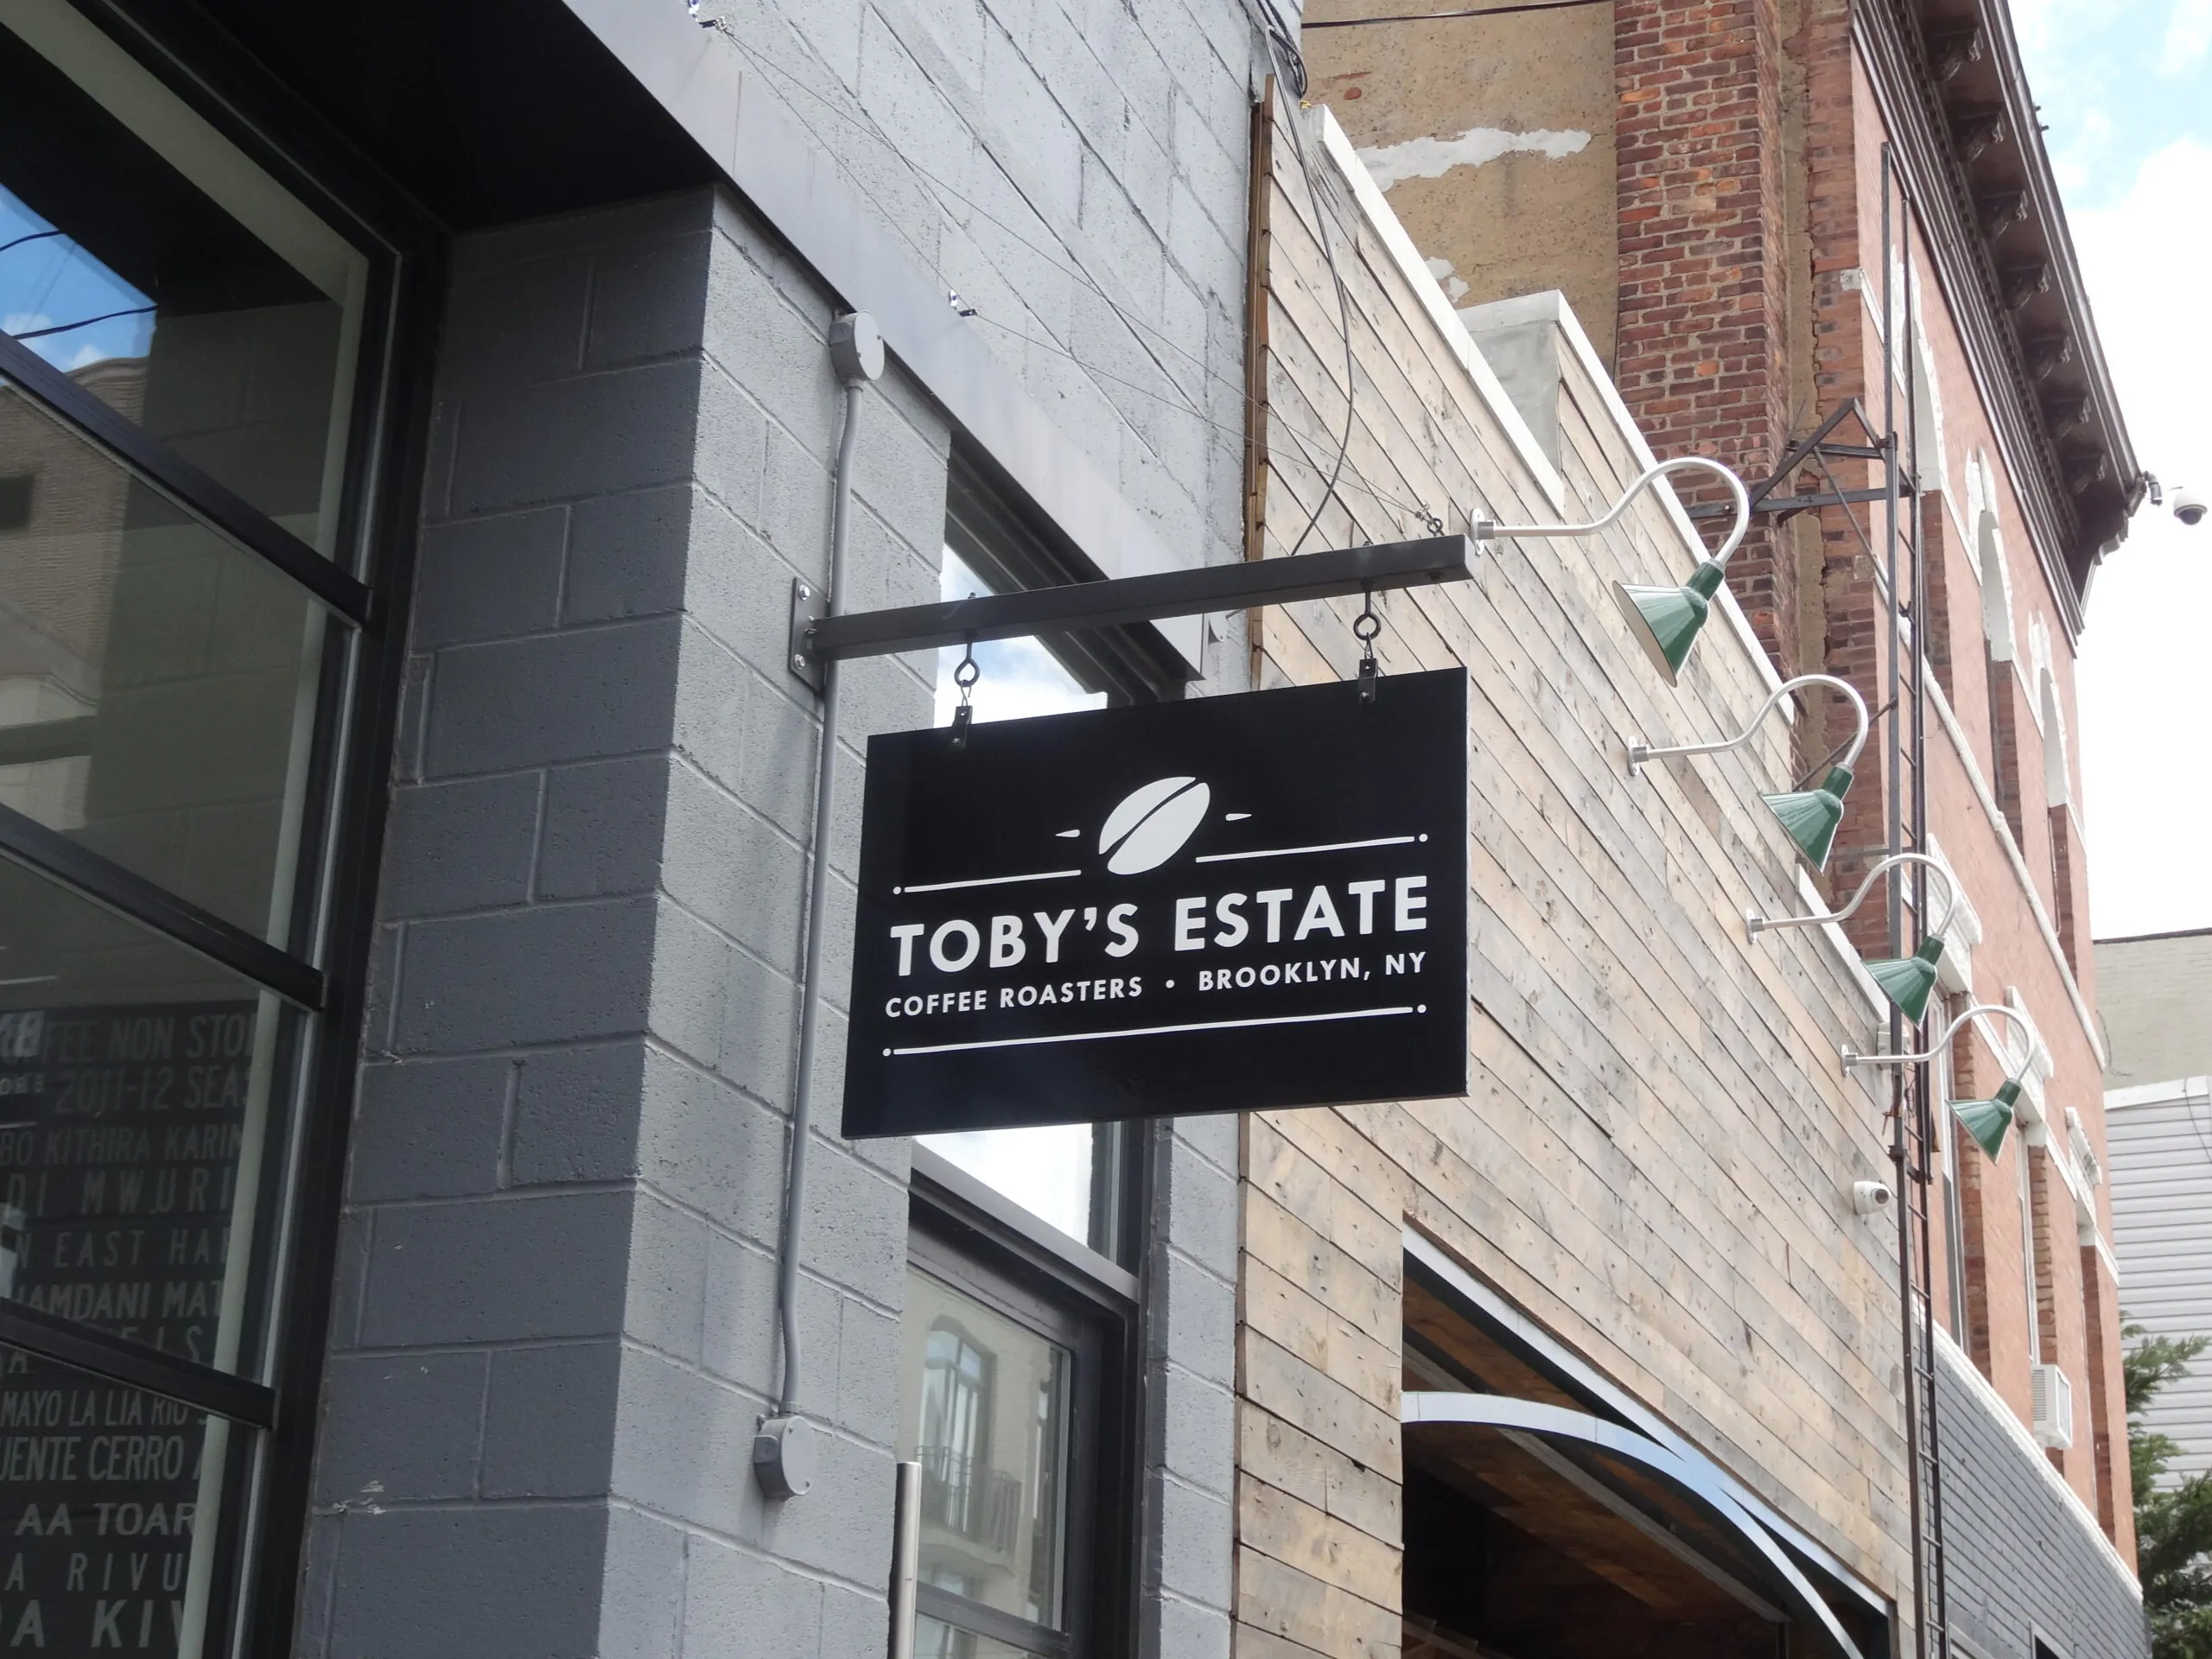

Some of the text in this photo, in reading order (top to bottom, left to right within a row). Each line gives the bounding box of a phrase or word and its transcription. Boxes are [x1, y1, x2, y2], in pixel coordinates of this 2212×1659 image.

[890, 875, 1427, 976] TOBY'S ESTATE
[885, 951, 1426, 1018] COFFEE ROASTERS BROOKLYN, NY
[110, 1017, 175, 1061] NON
[53, 1066, 175, 1115] 2011-12
[44, 1127, 150, 1165] KITHIRA
[54, 1230, 145, 1268] EAST
[68, 1389, 96, 1427] LA
[105, 1389, 143, 1427] LIA
[88, 1433, 185, 1481] CERRO
[14, 1503, 73, 1536] AA
